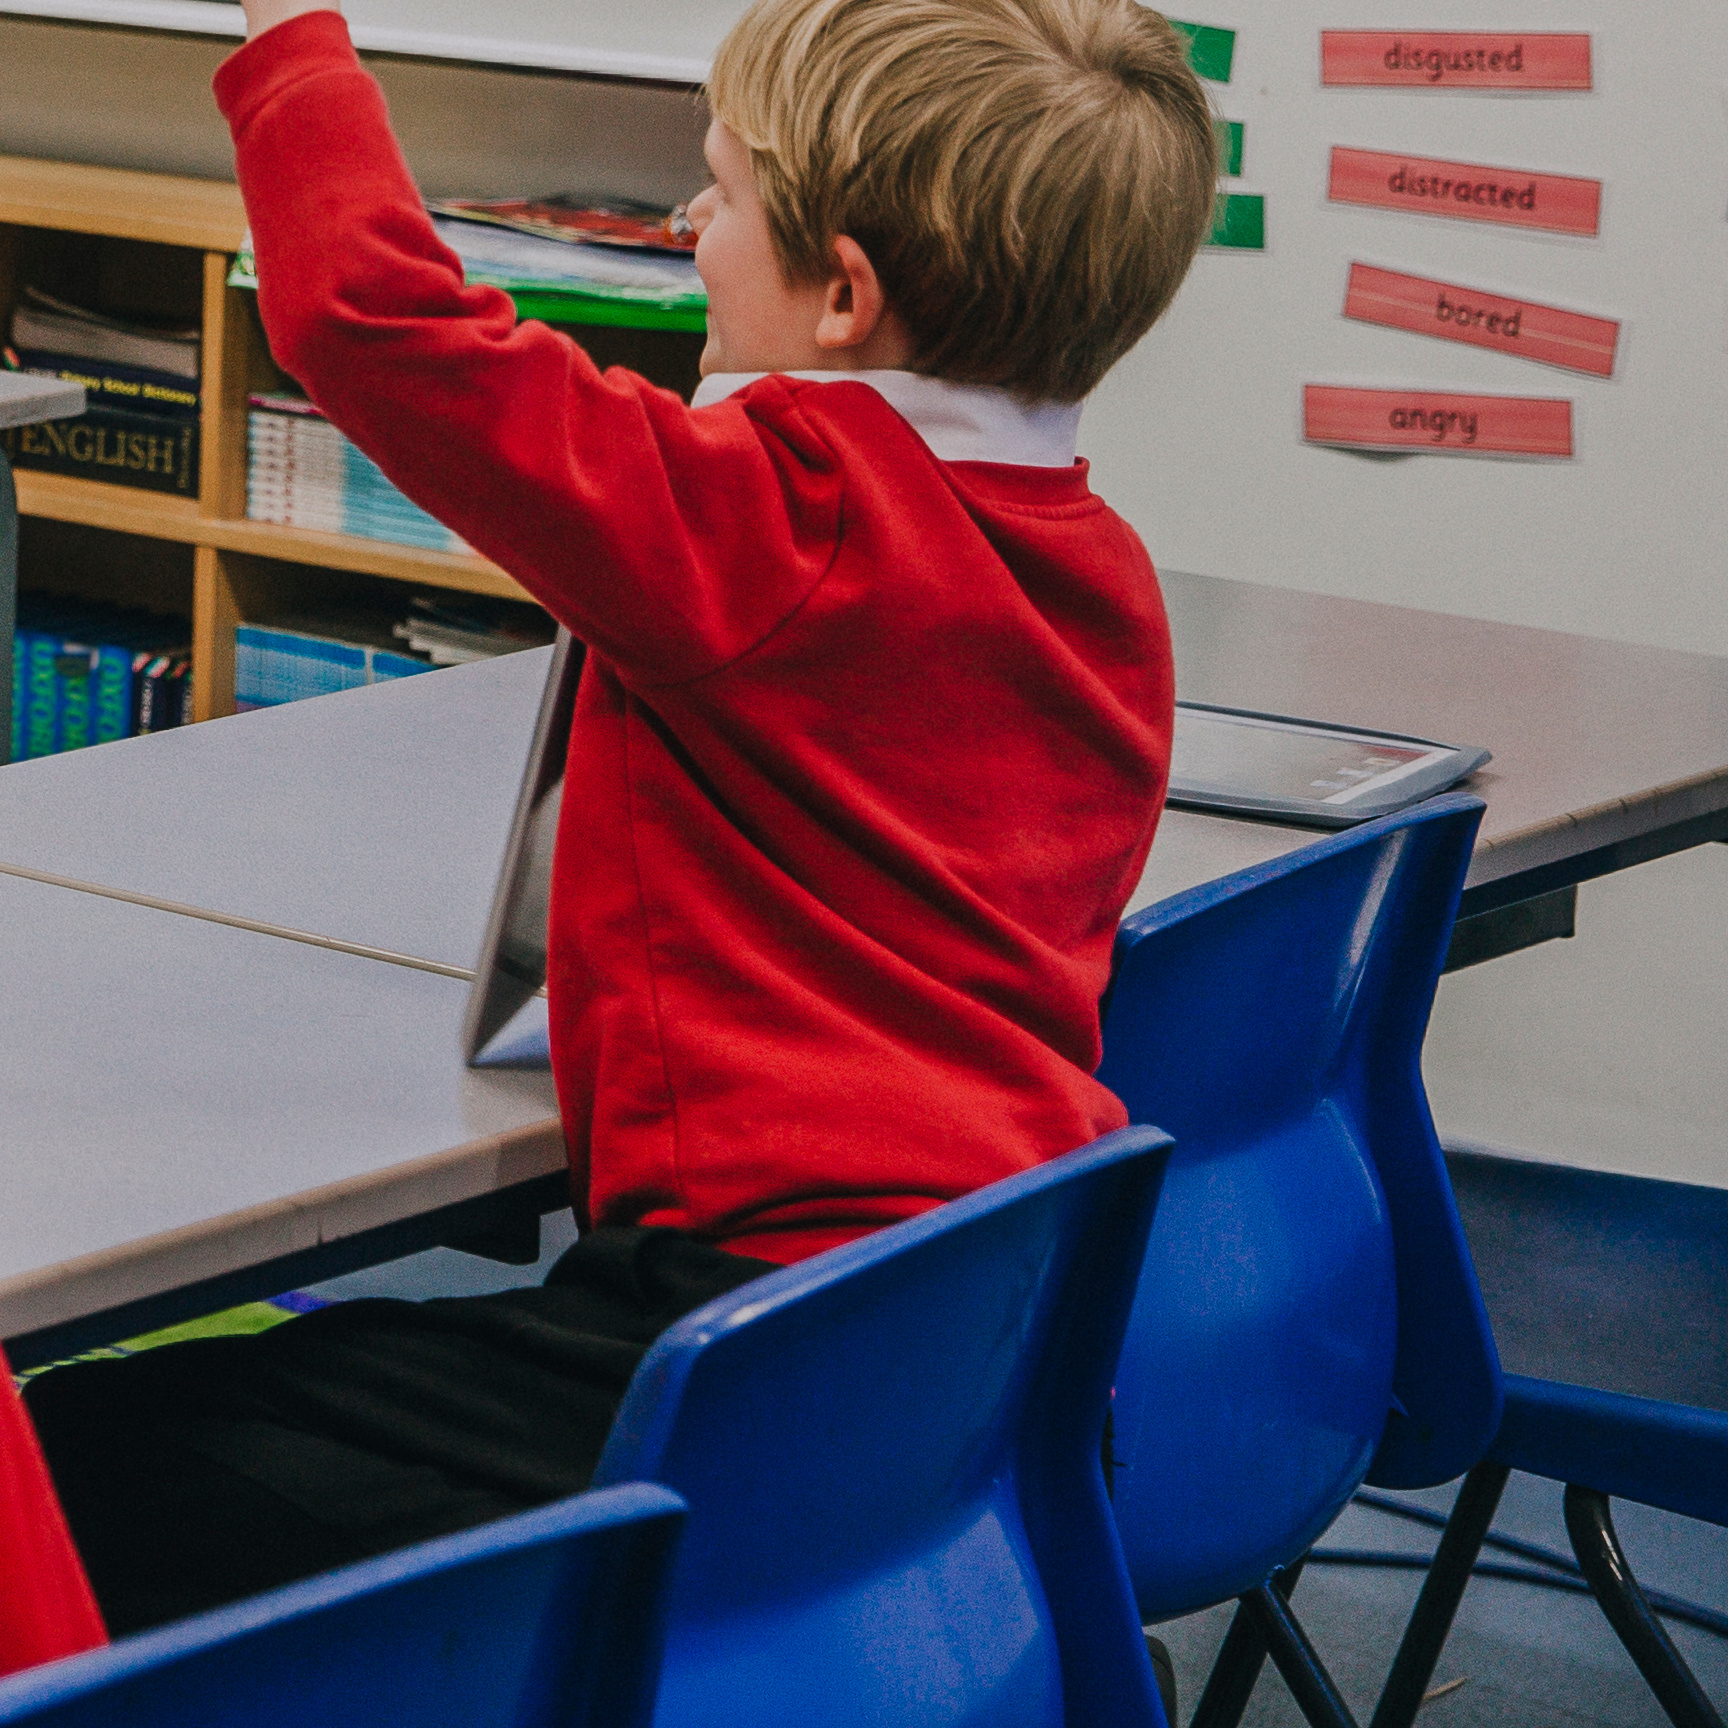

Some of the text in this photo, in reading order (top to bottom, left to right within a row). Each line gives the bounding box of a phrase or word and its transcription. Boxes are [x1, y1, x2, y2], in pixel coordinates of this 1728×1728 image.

[1382, 41, 1525, 84] disgusted
[1387, 165, 1538, 212] distracted
[1436, 292, 1524, 339] bored
[20, 421, 175, 476] ENGLISH
[1388, 405, 1480, 445] angry
[98, 657, 126, 744] OXFO
